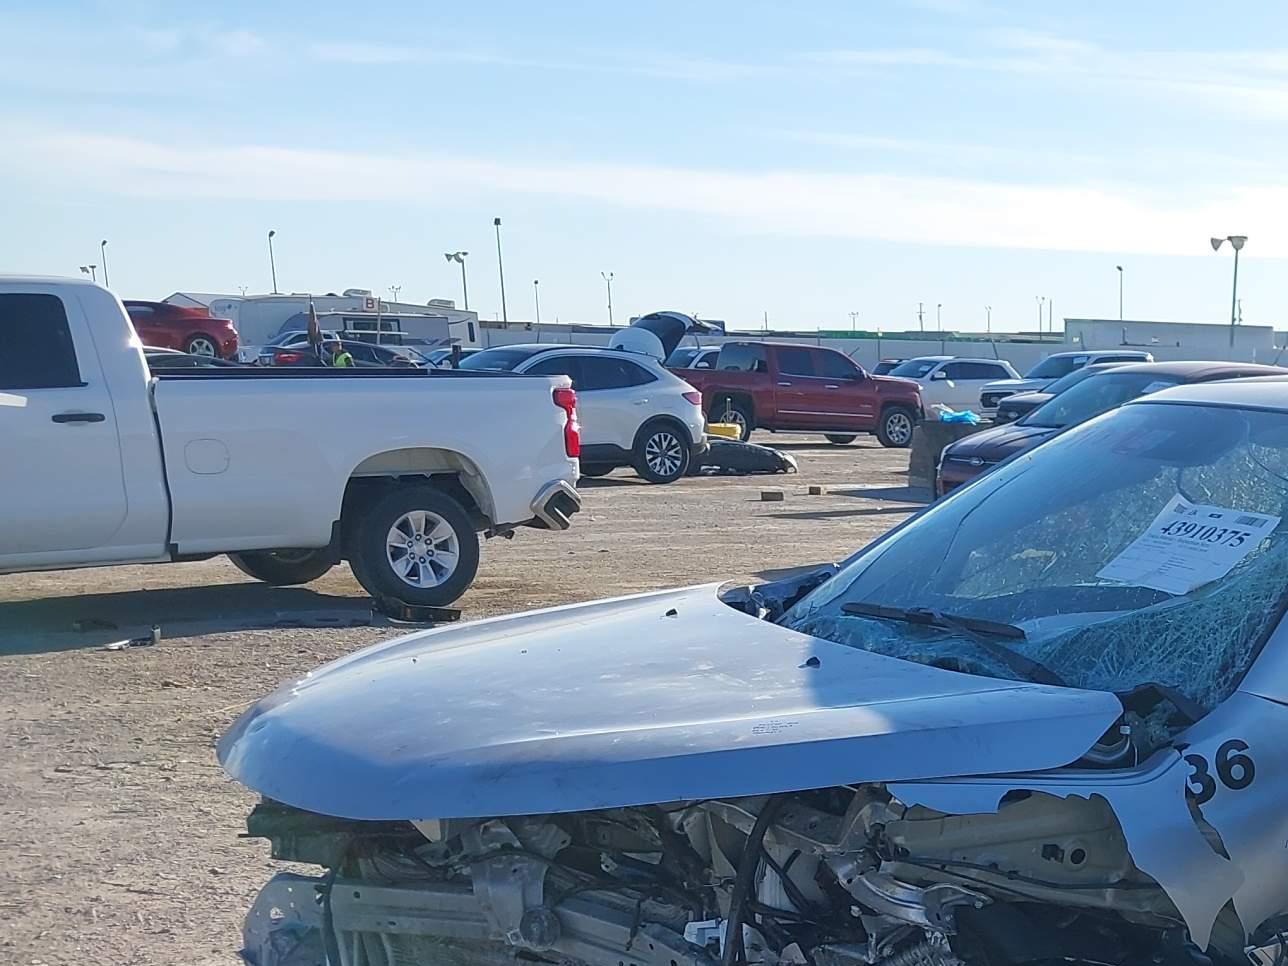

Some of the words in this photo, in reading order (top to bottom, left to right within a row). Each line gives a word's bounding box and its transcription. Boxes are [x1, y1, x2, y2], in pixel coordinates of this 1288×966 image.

[365, 298, 375, 309] B
[1160, 520, 1252, 548] 43910375
[1183, 738, 1256, 805] 36
